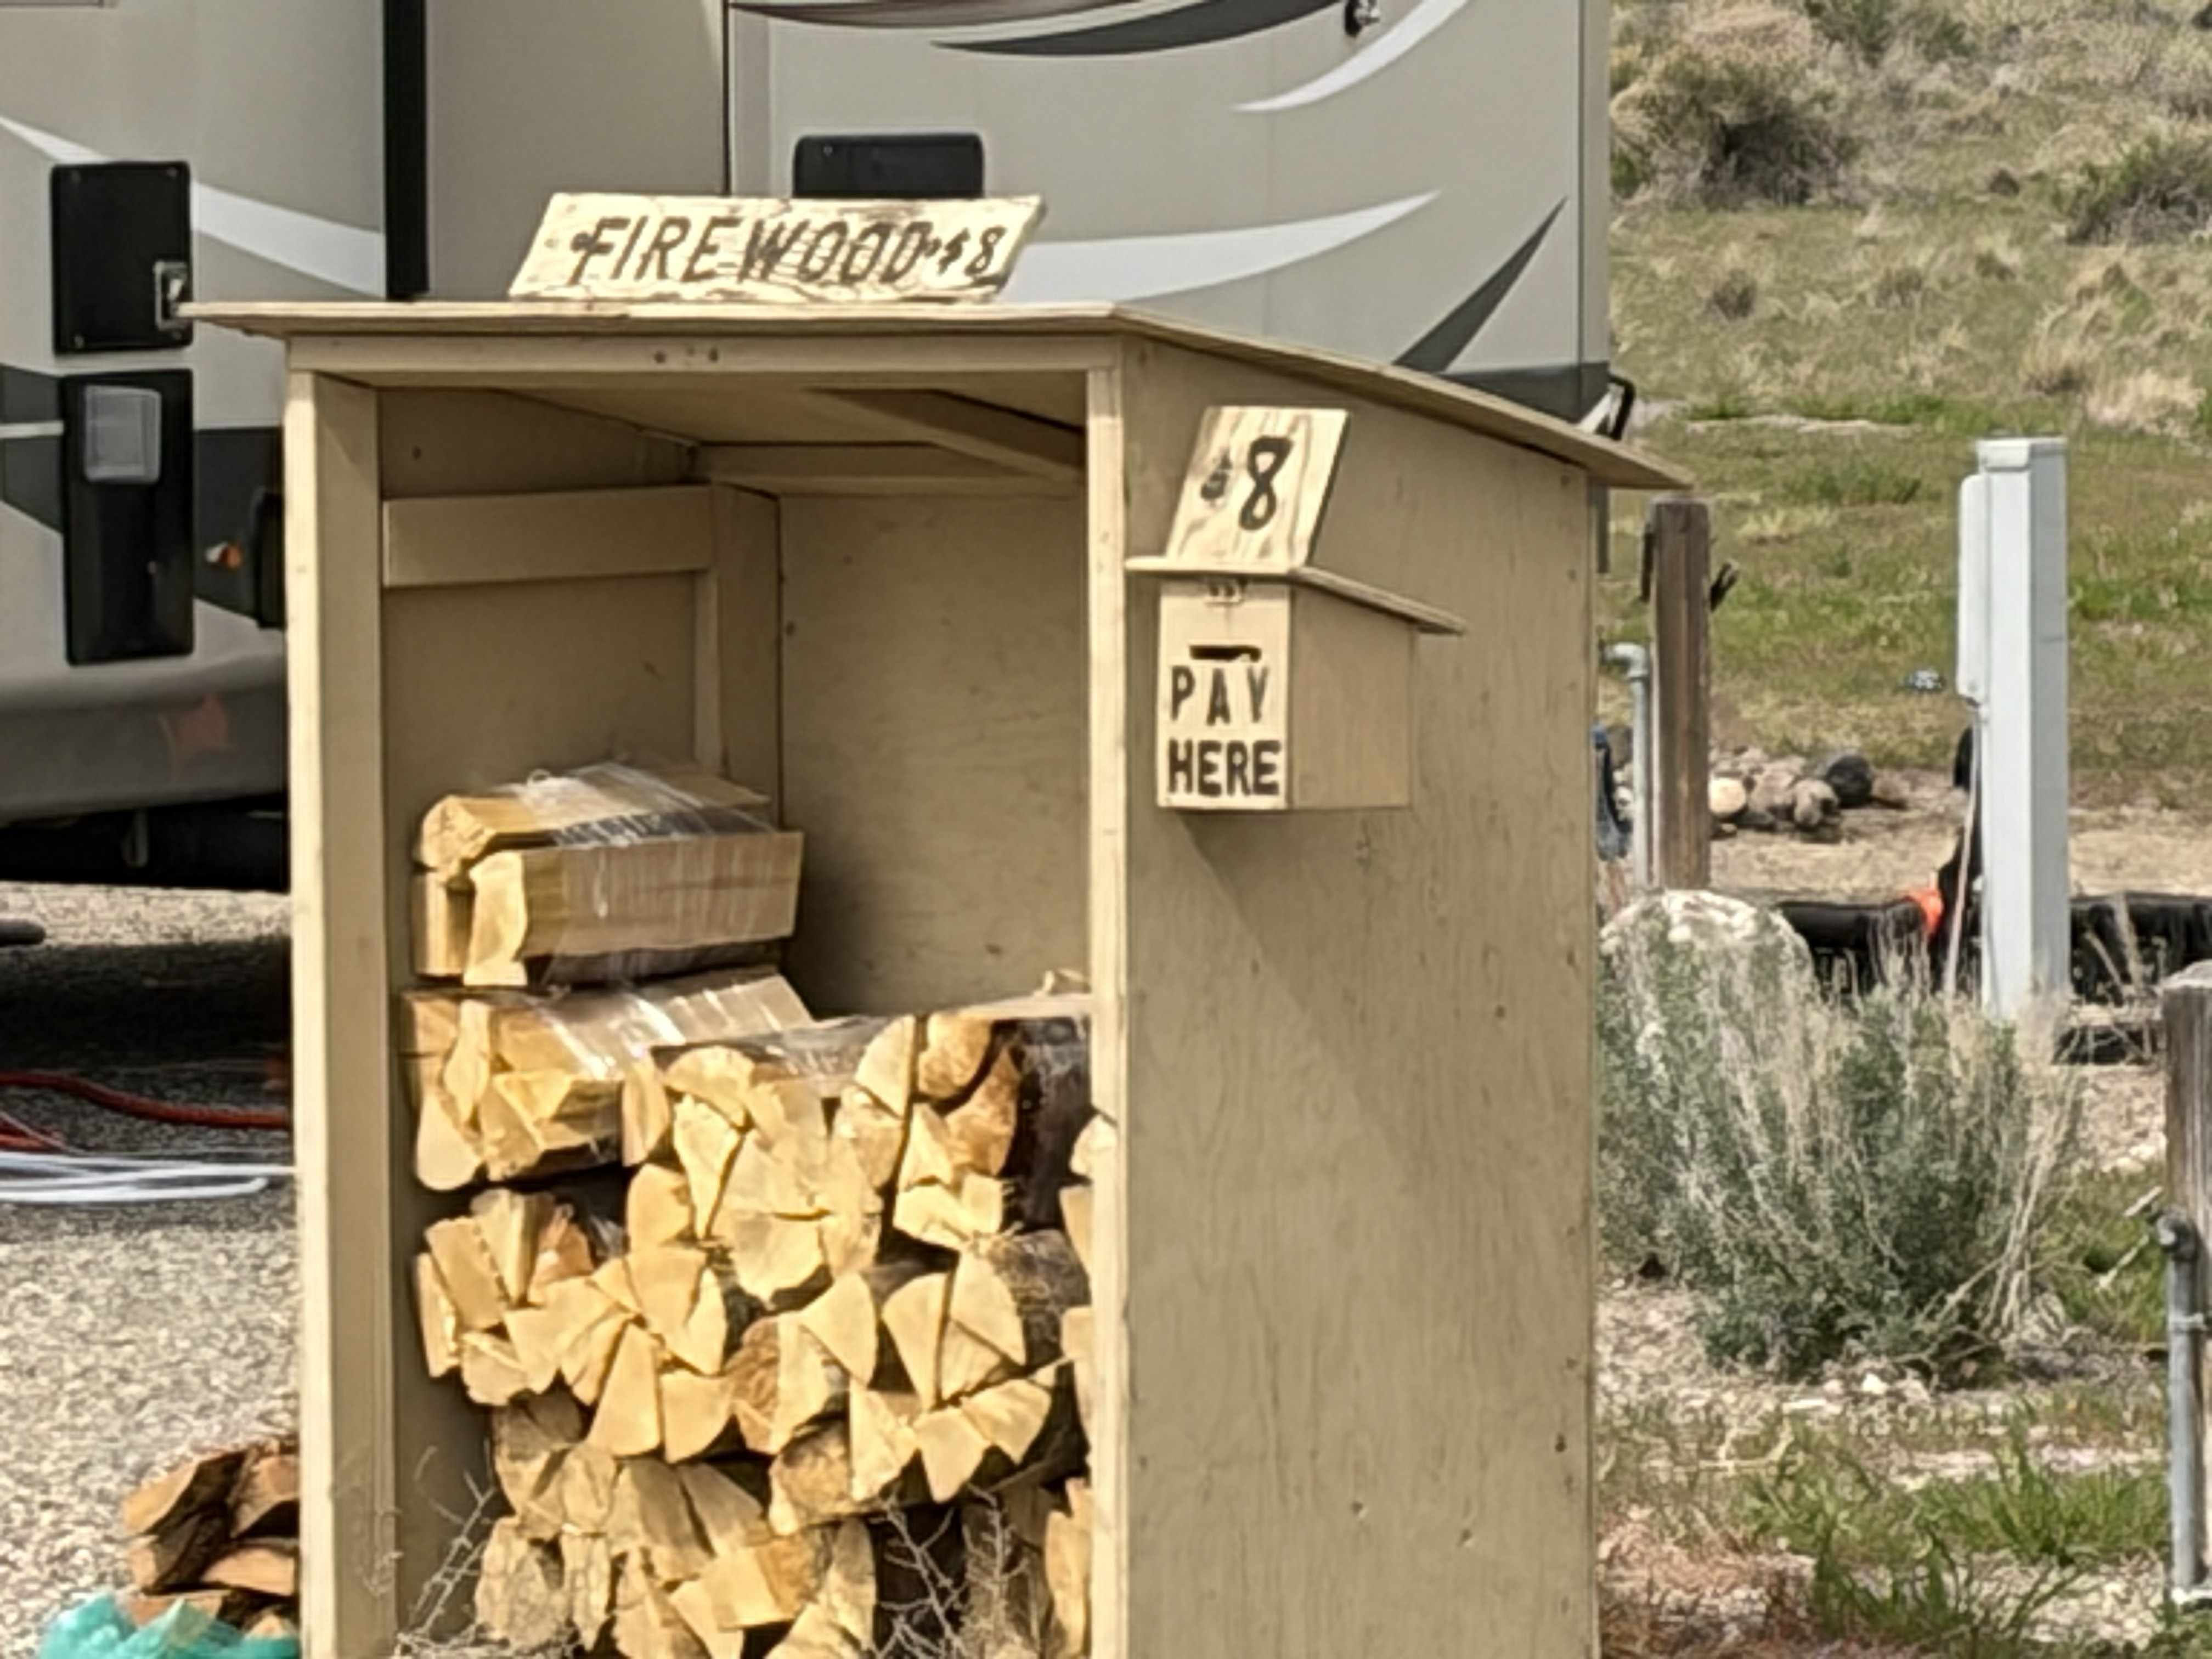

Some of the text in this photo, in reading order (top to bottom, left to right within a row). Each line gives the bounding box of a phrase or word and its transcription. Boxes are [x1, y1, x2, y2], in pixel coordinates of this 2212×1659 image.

[566, 216, 932, 285] FIREWOOD
[1171, 665, 1268, 726] PAY
[1168, 738, 1282, 797] HERE
